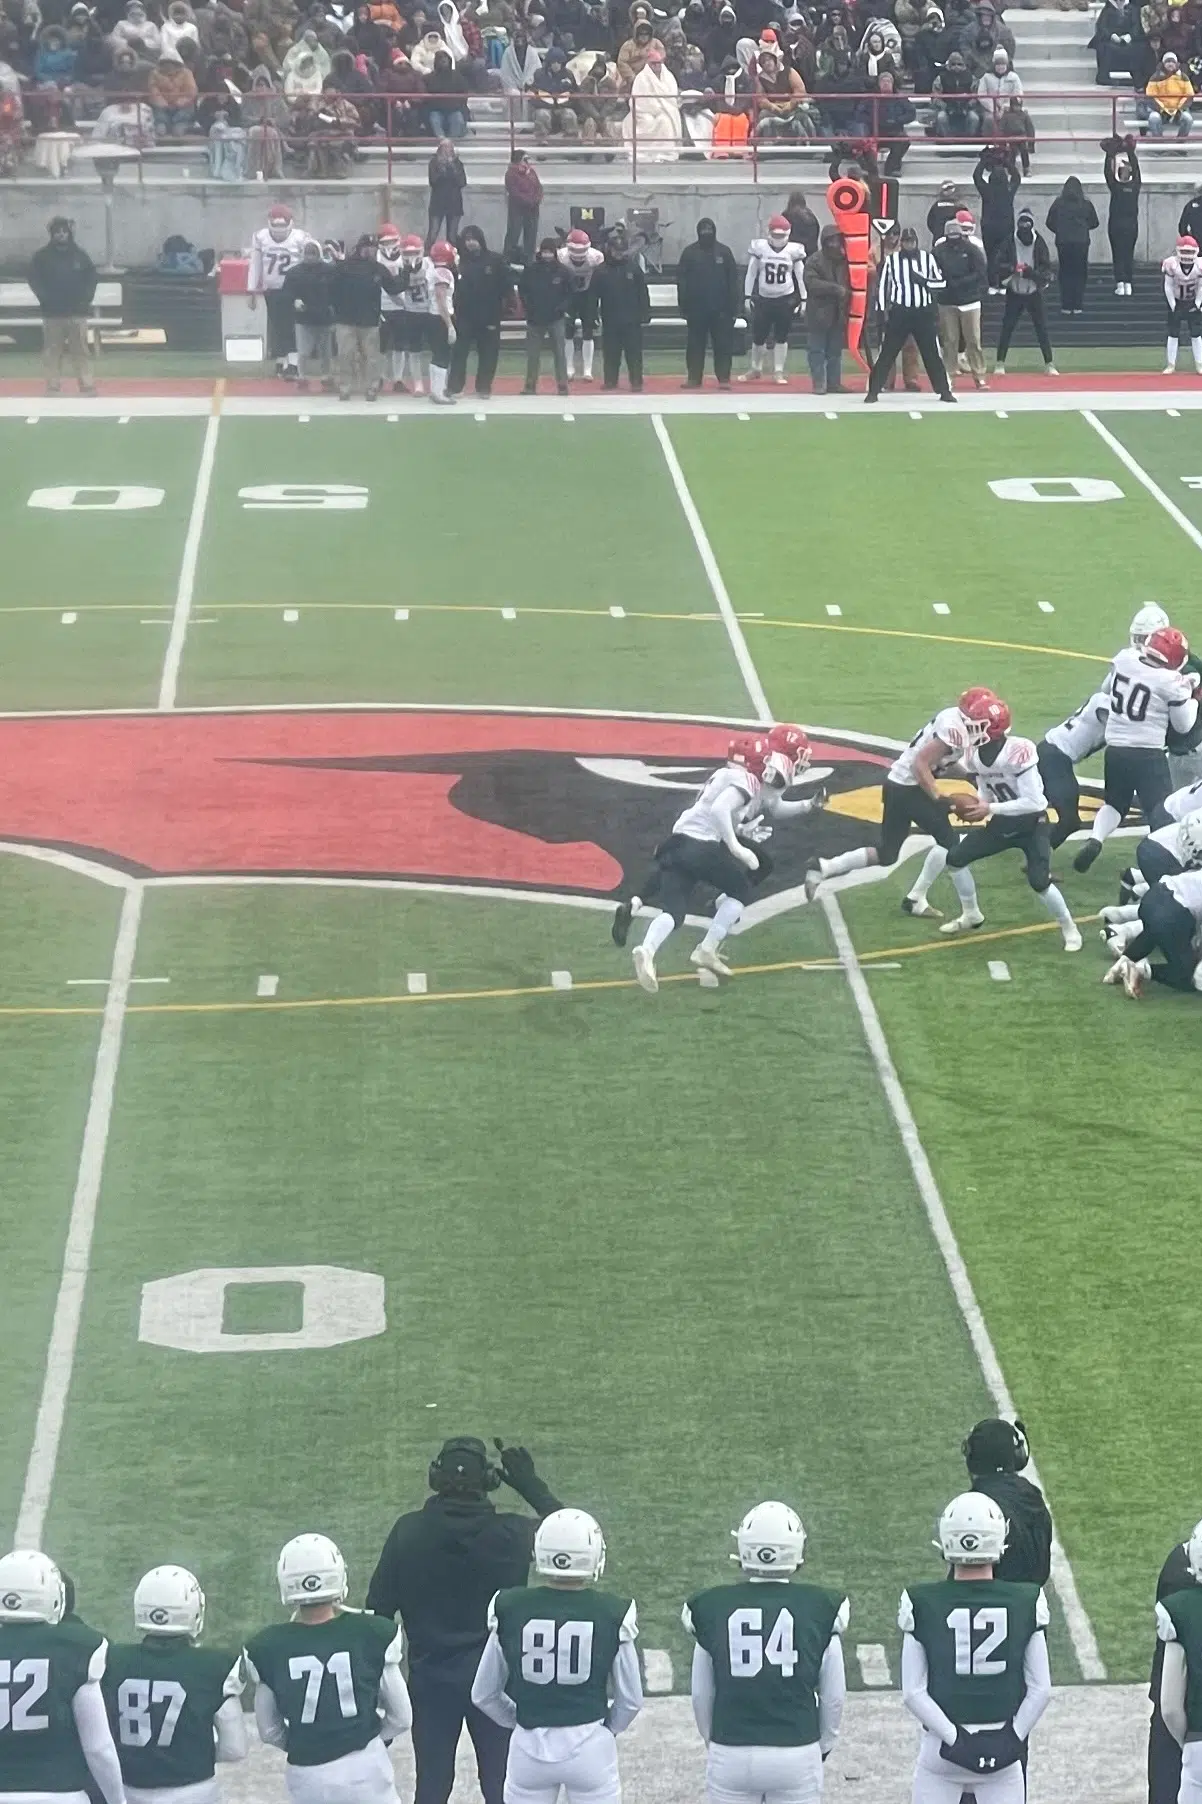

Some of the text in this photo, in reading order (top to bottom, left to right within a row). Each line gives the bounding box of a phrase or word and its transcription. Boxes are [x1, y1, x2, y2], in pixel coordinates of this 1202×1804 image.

[267, 253, 291, 276] 72
[1178, 284, 1196, 300] 15
[1111, 672, 1151, 721] 50
[137, 1265, 387, 1353] 0
[522, 1619, 593, 1686] 80
[727, 1607, 798, 1677] 64
[946, 1607, 1008, 1676] 12
[117, 1678, 188, 1747] 87
[289, 1651, 359, 1725] 71
